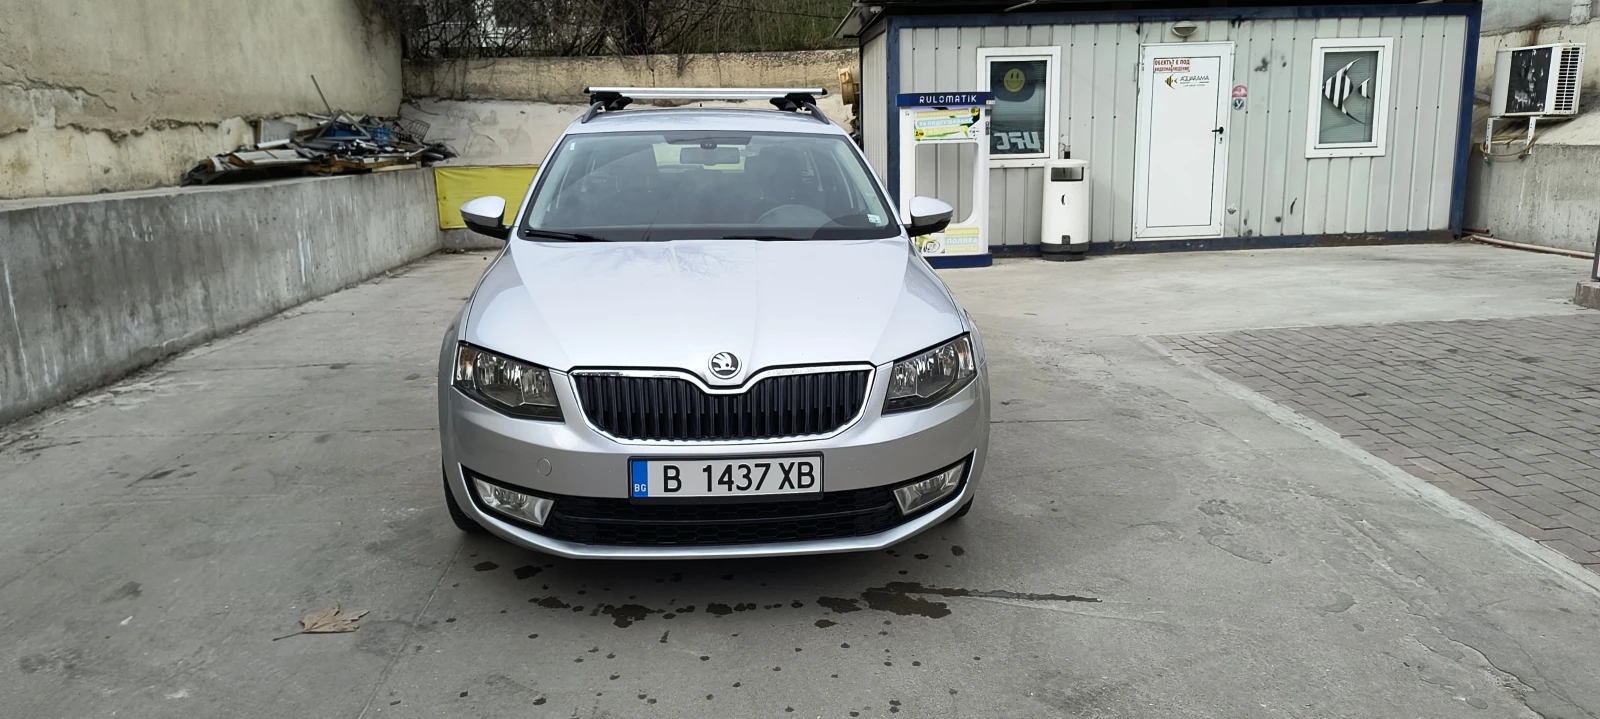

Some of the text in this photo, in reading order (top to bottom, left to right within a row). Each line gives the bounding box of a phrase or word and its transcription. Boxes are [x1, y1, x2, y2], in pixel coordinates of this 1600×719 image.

[919, 94, 977, 104] RULOMATIK
[946, 237, 978, 245] ПОЛИРА
[663, 461, 815, 493] B 1437 XB
[634, 484, 647, 492] BG
